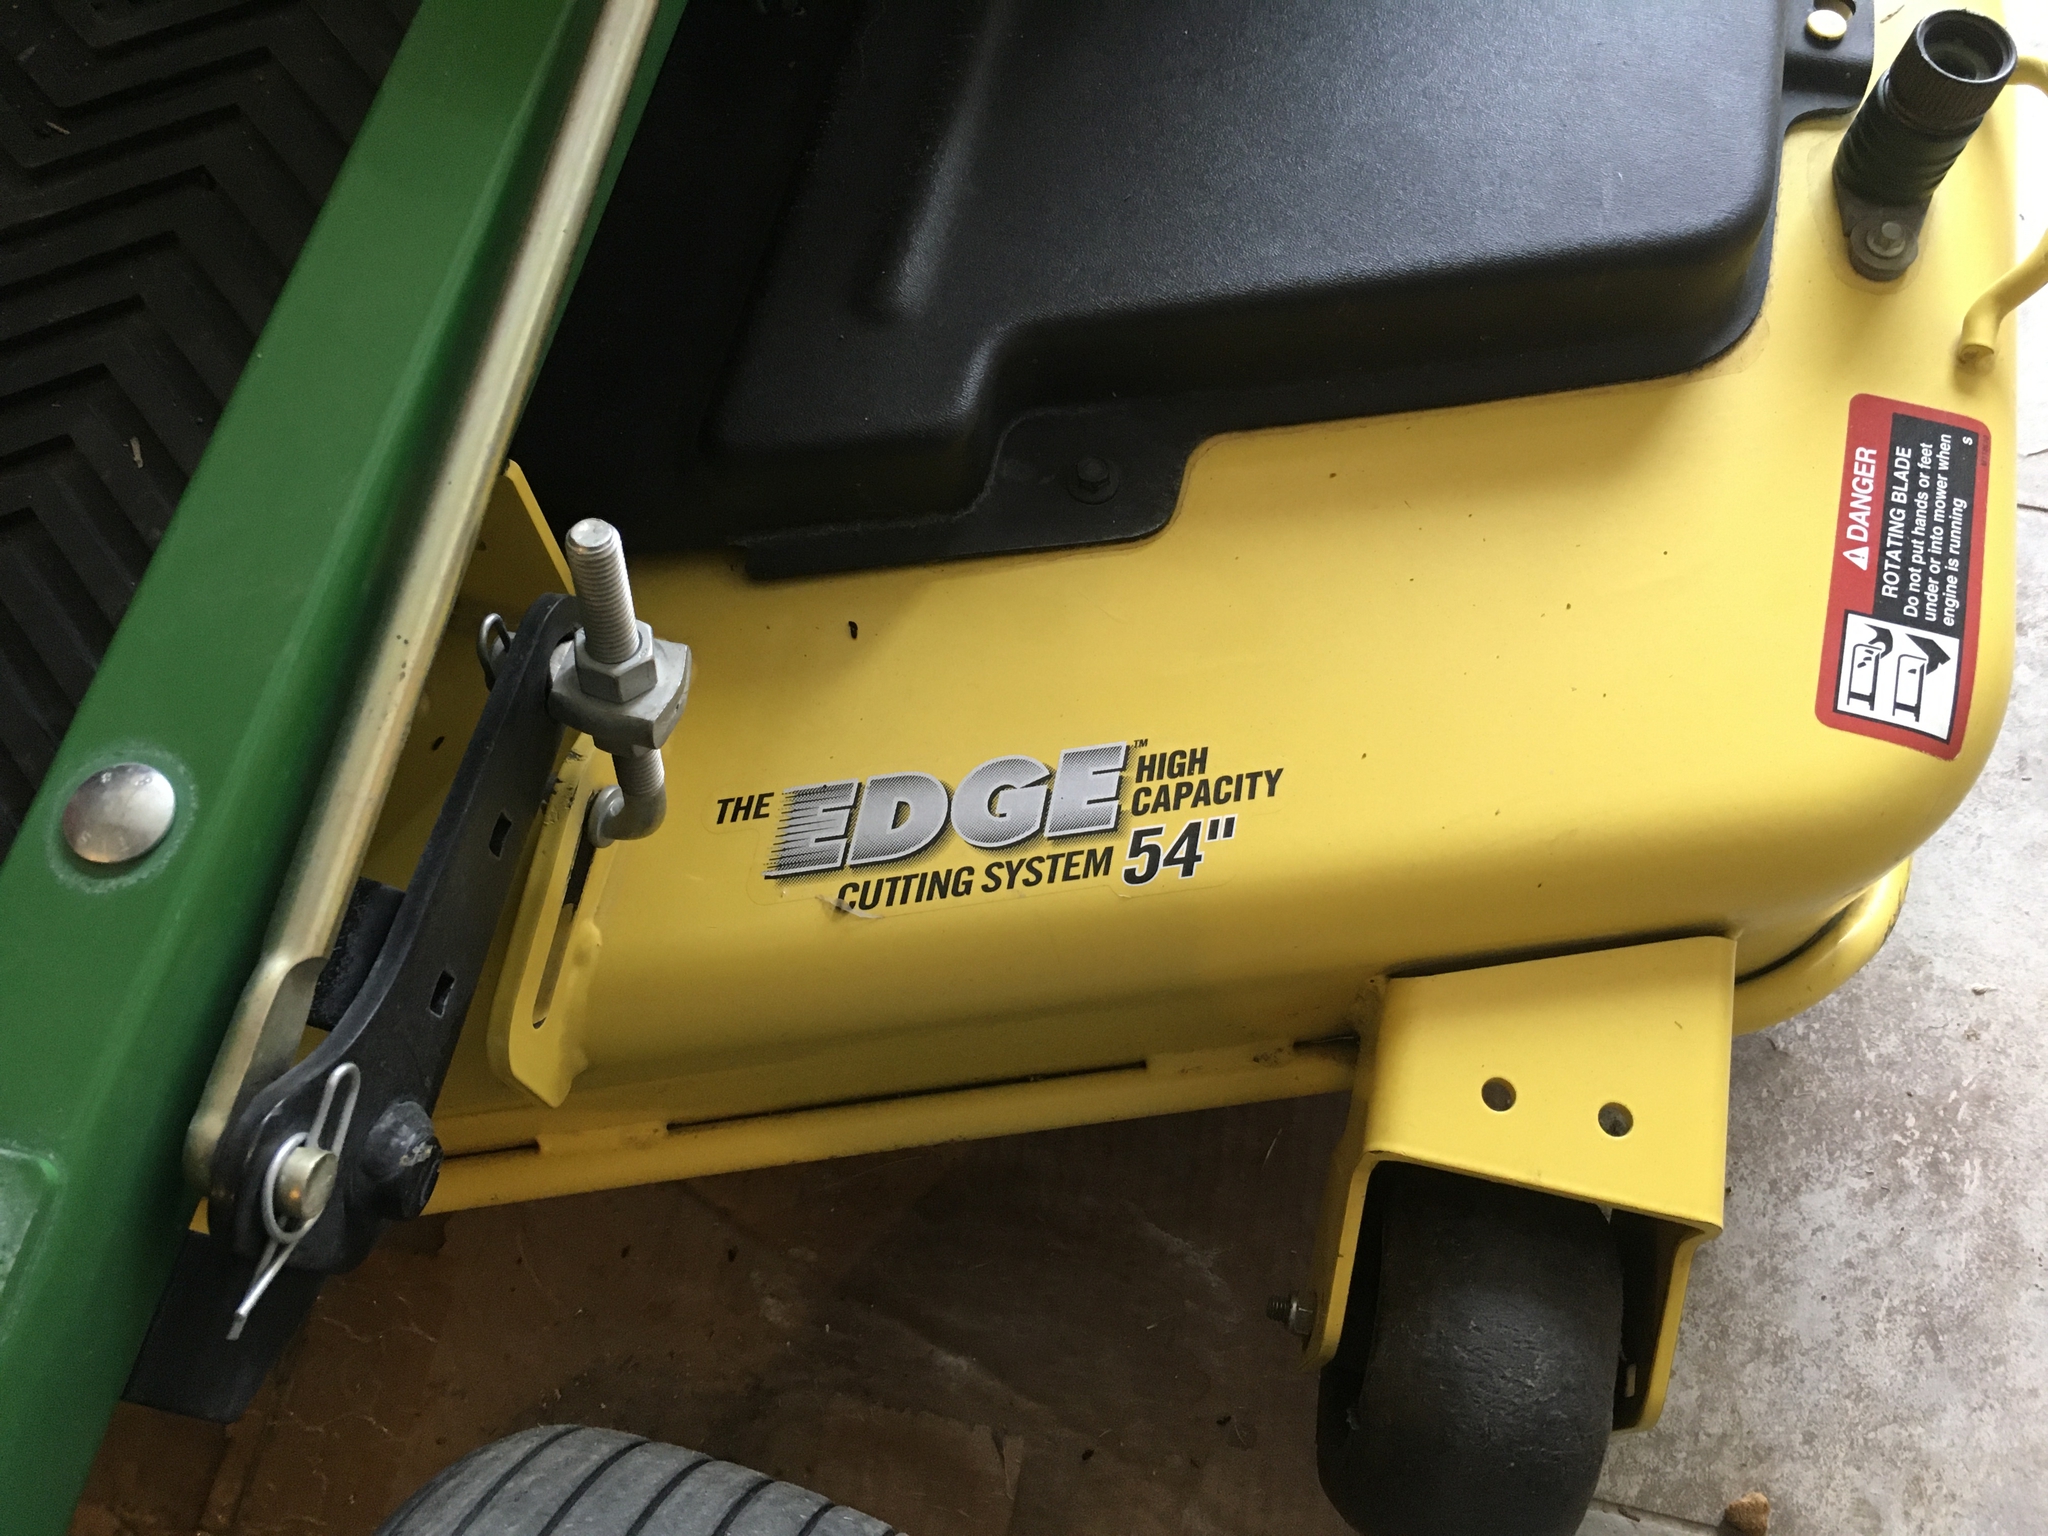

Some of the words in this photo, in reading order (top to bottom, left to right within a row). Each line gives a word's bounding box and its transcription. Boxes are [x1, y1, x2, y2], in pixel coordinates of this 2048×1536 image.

[1890, 445, 1912, 505] BLADE
[1917, 442, 1934, 470] feet
[1935, 433, 1952, 471] when
[1845, 446, 1878, 543] DANGER
[1918, 471, 1931, 488] or
[1932, 473, 1949, 523] mower
[1910, 491, 1929, 537] hands
[1948, 497, 1968, 555] running
[1881, 507, 1907, 599] ROTATING
[1911, 539, 1927, 566] put
[1927, 525, 1944, 555] into
[1908, 566, 1923, 593] not
[1929, 556, 1942, 574] or
[1944, 557, 1960, 572] is
[1902, 595, 1920, 618] Do
[1923, 576, 1940, 622] under
[1942, 574, 1960, 627] engine
[1135, 746, 1209, 783] HIGH
[716, 792, 775, 825] THE
[763, 741, 1130, 880] EDGE
[1131, 767, 1284, 816] CAPACITY
[1121, 813, 1239, 887] 54"
[838, 865, 974, 911] CUTTING
[981, 846, 1114, 892] SYSTEM
